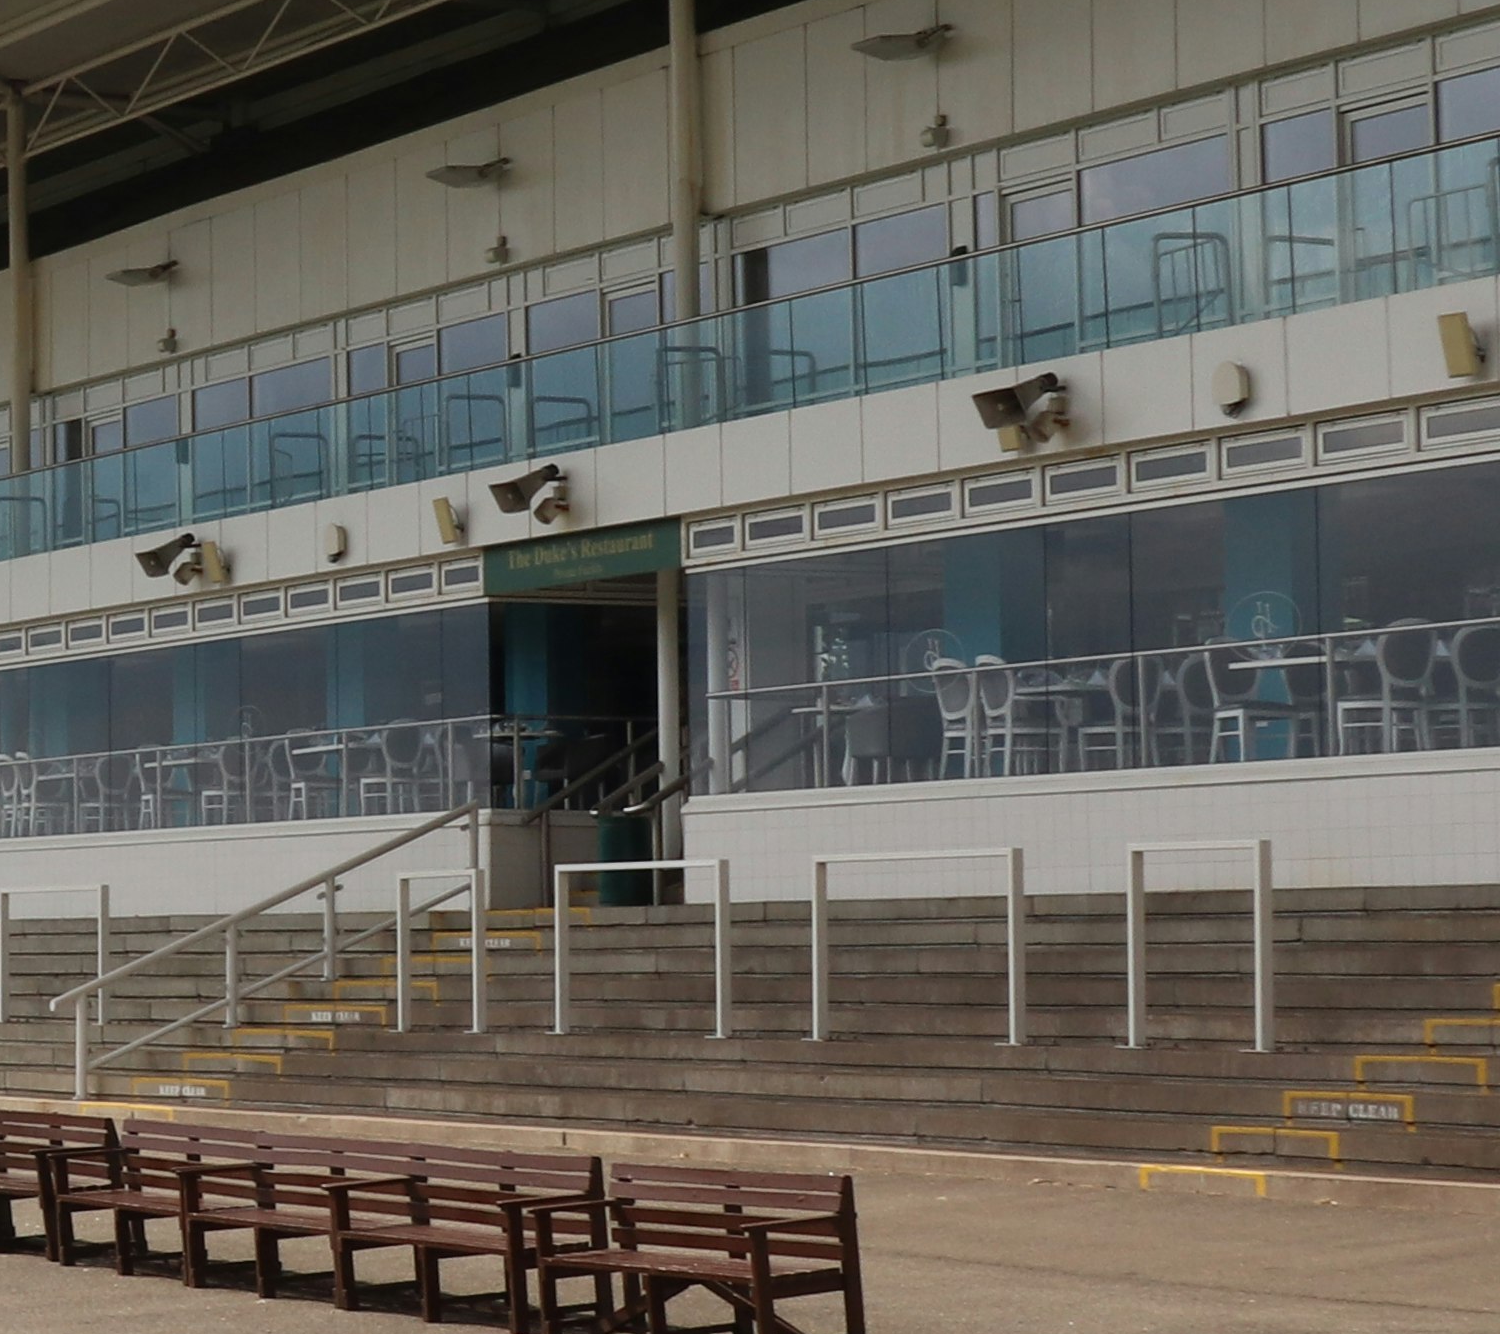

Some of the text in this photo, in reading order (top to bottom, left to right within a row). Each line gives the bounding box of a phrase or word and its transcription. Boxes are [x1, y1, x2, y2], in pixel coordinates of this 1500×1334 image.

[508, 533, 654, 569] The Duke's Restaurant
[1297, 1100, 1399, 1119] KEEP CLEAR
